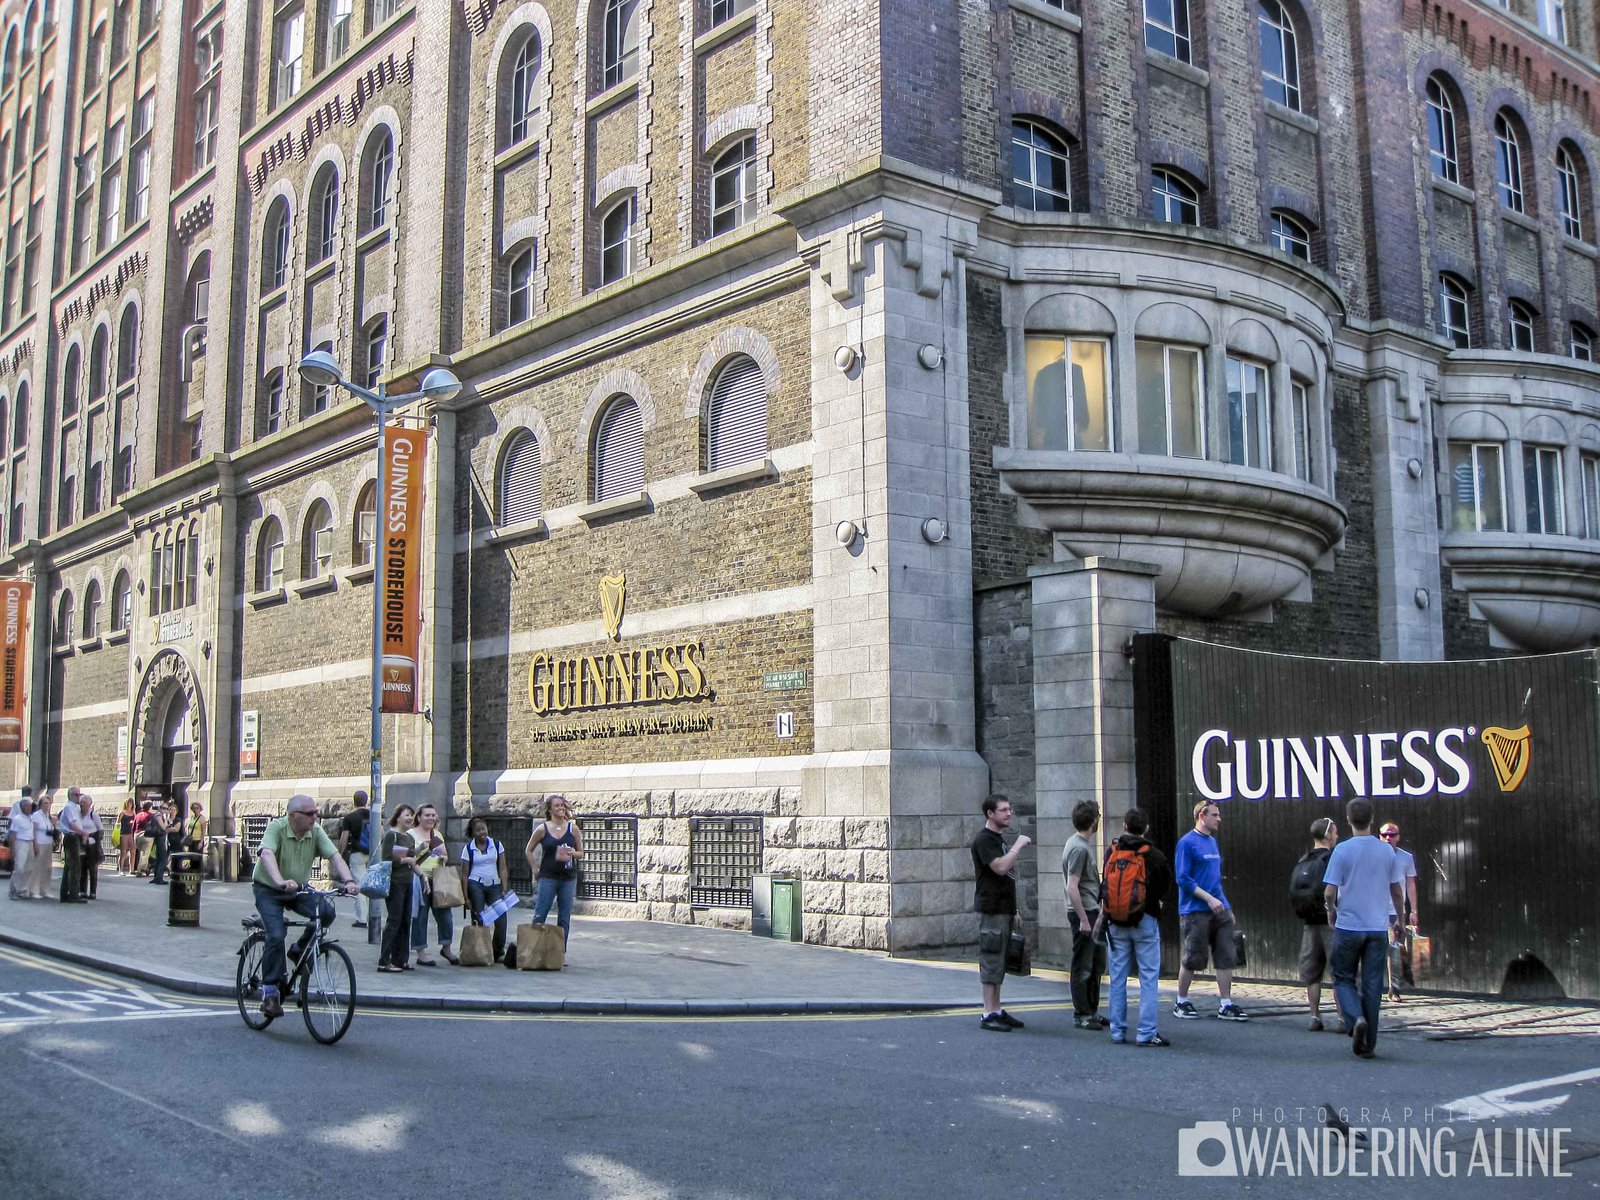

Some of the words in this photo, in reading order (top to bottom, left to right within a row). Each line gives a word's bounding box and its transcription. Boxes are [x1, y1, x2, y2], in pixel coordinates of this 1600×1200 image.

[389, 438, 413, 532] GUINNESS
[6, 587, 21, 645] GUINNESS
[386, 537, 406, 643] STOREHOUSE
[4, 647, 17, 710] STOREHOUSE
[383, 682, 412, 692] UINNESS
[528, 643, 702, 714] GUINNESS
[668, 711, 709, 729] DUBLIN
[1192, 727, 1472, 801] GUINNESS
